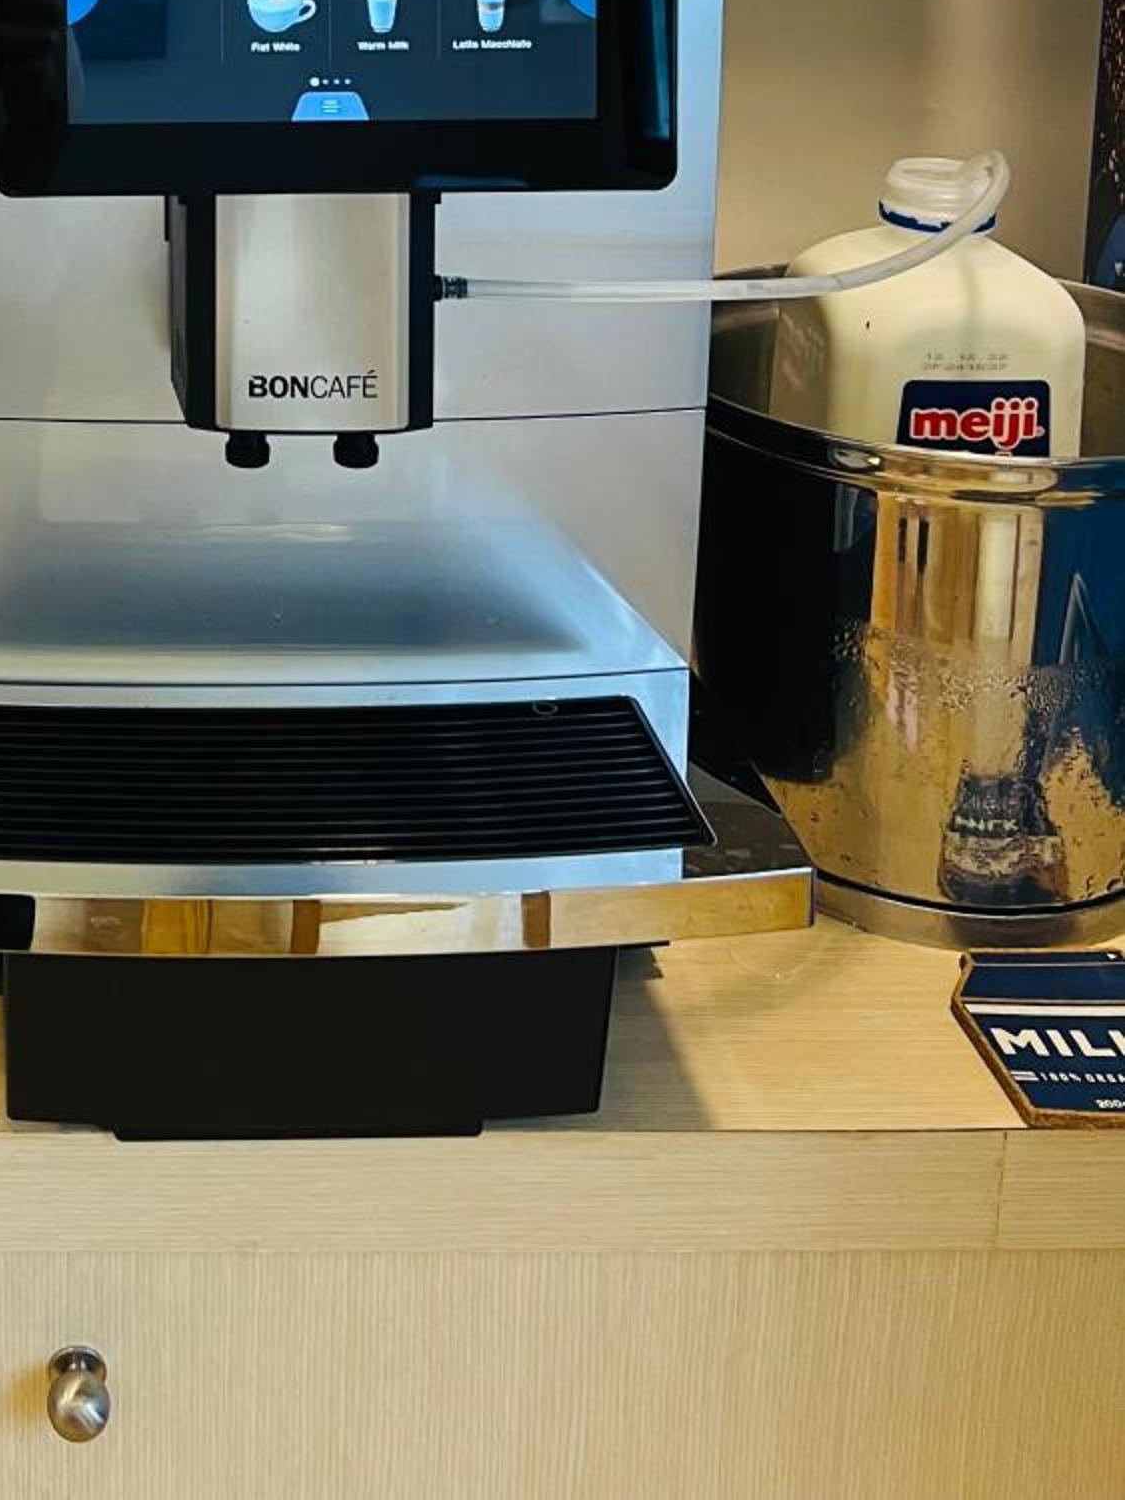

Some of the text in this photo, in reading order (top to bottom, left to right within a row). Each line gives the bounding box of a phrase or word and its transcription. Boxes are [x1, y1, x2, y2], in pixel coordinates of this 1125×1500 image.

[273, 41, 301, 52] White
[452, 39, 532, 50] Latte Macchiato
[248, 369, 379, 399] BONCAFÉ
[910, 398, 1039, 450] meiji
